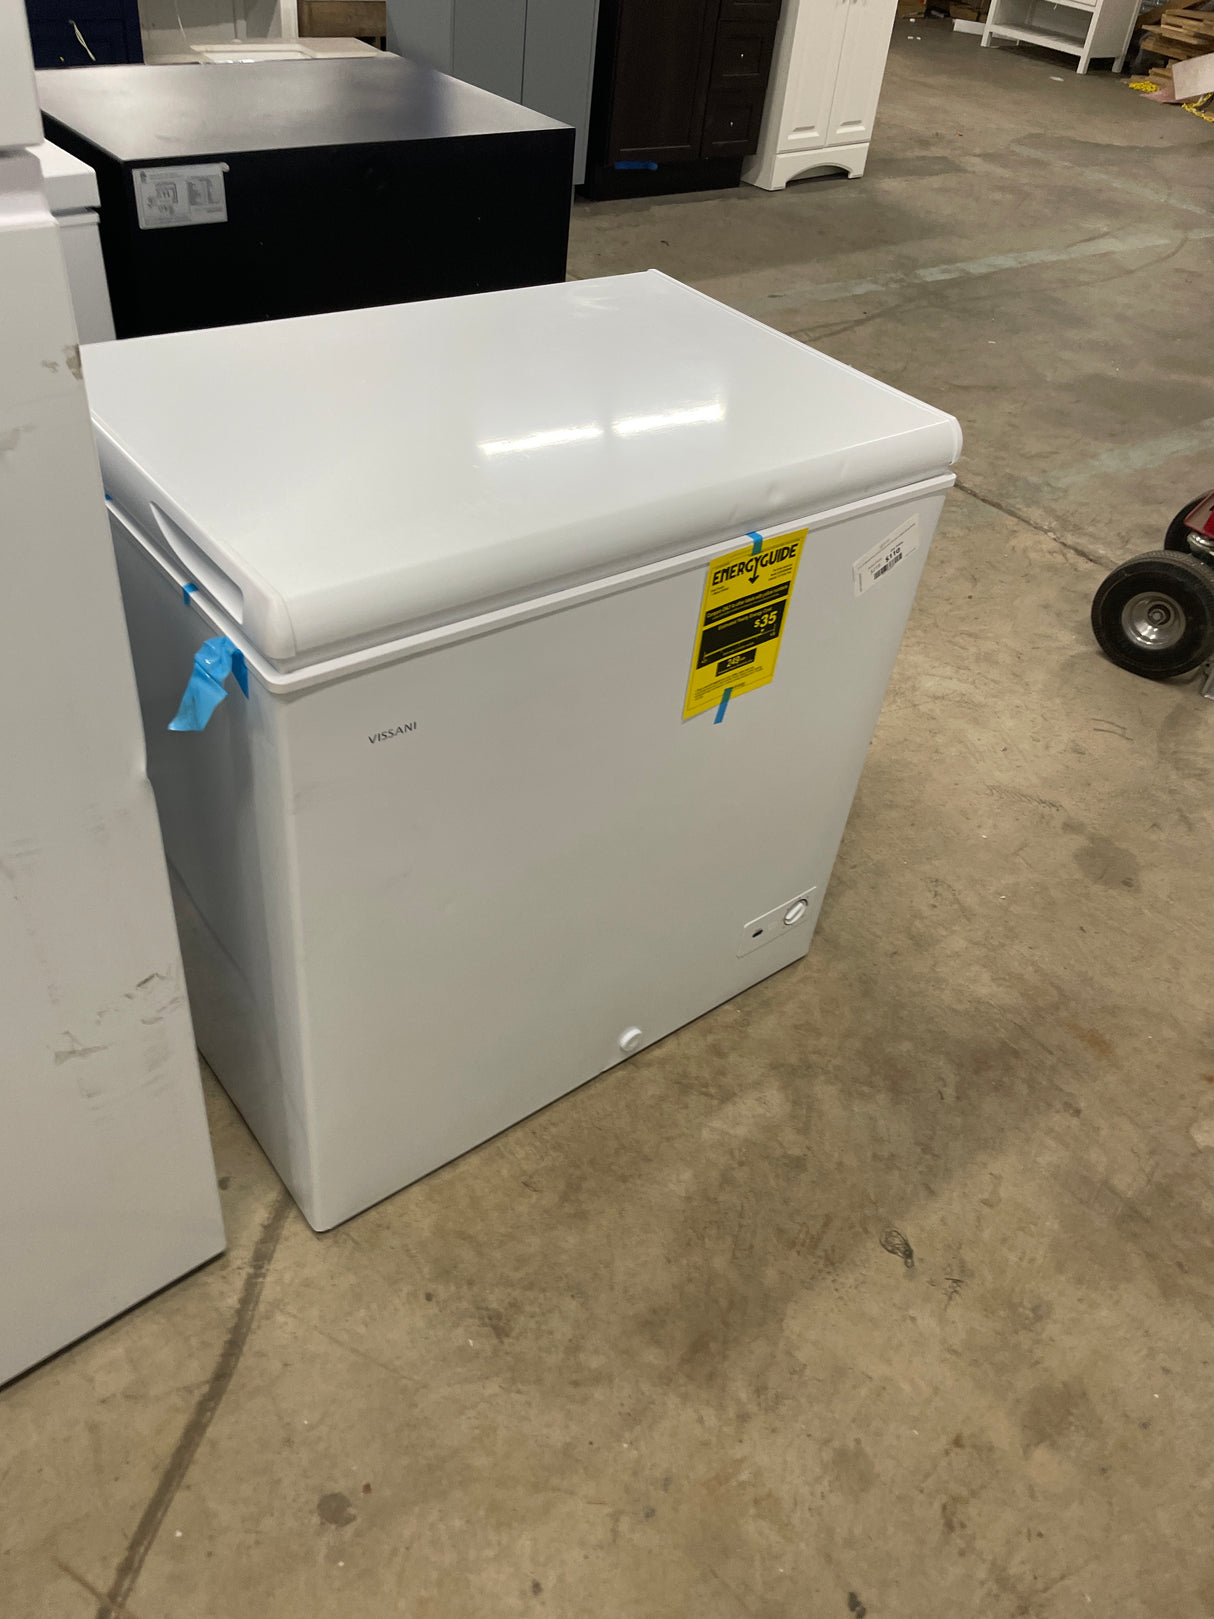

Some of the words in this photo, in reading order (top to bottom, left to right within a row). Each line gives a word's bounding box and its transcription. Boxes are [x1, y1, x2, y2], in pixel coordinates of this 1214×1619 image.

[712, 543, 799, 586] ENERGYGUIDE
[753, 610, 778, 628] $35
[368, 721, 417, 744] VISSANI
